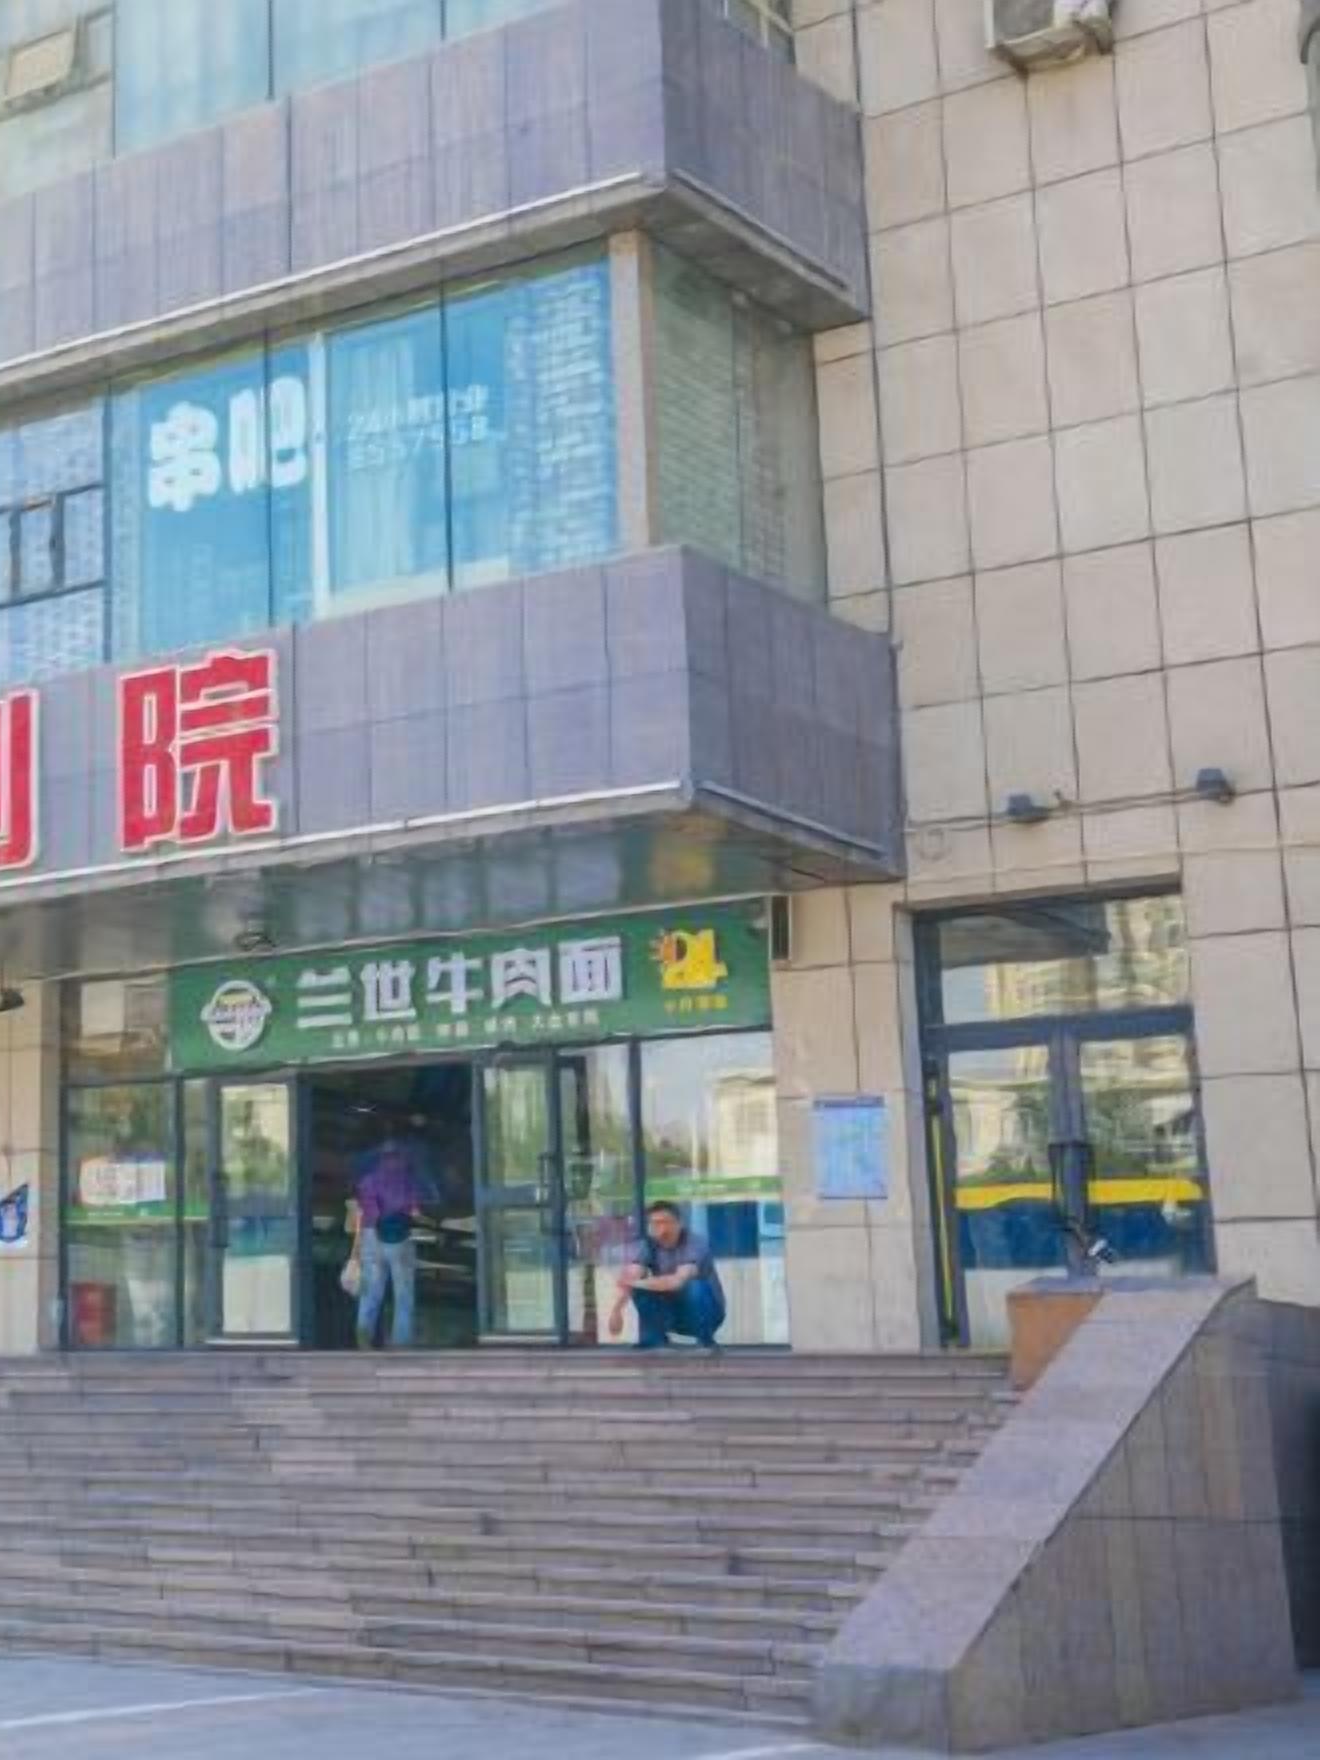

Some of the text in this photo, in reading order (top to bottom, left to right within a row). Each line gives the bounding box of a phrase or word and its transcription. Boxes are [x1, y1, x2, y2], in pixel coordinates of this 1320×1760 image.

[296, 937, 623, 1030] 兰世牛肉面
